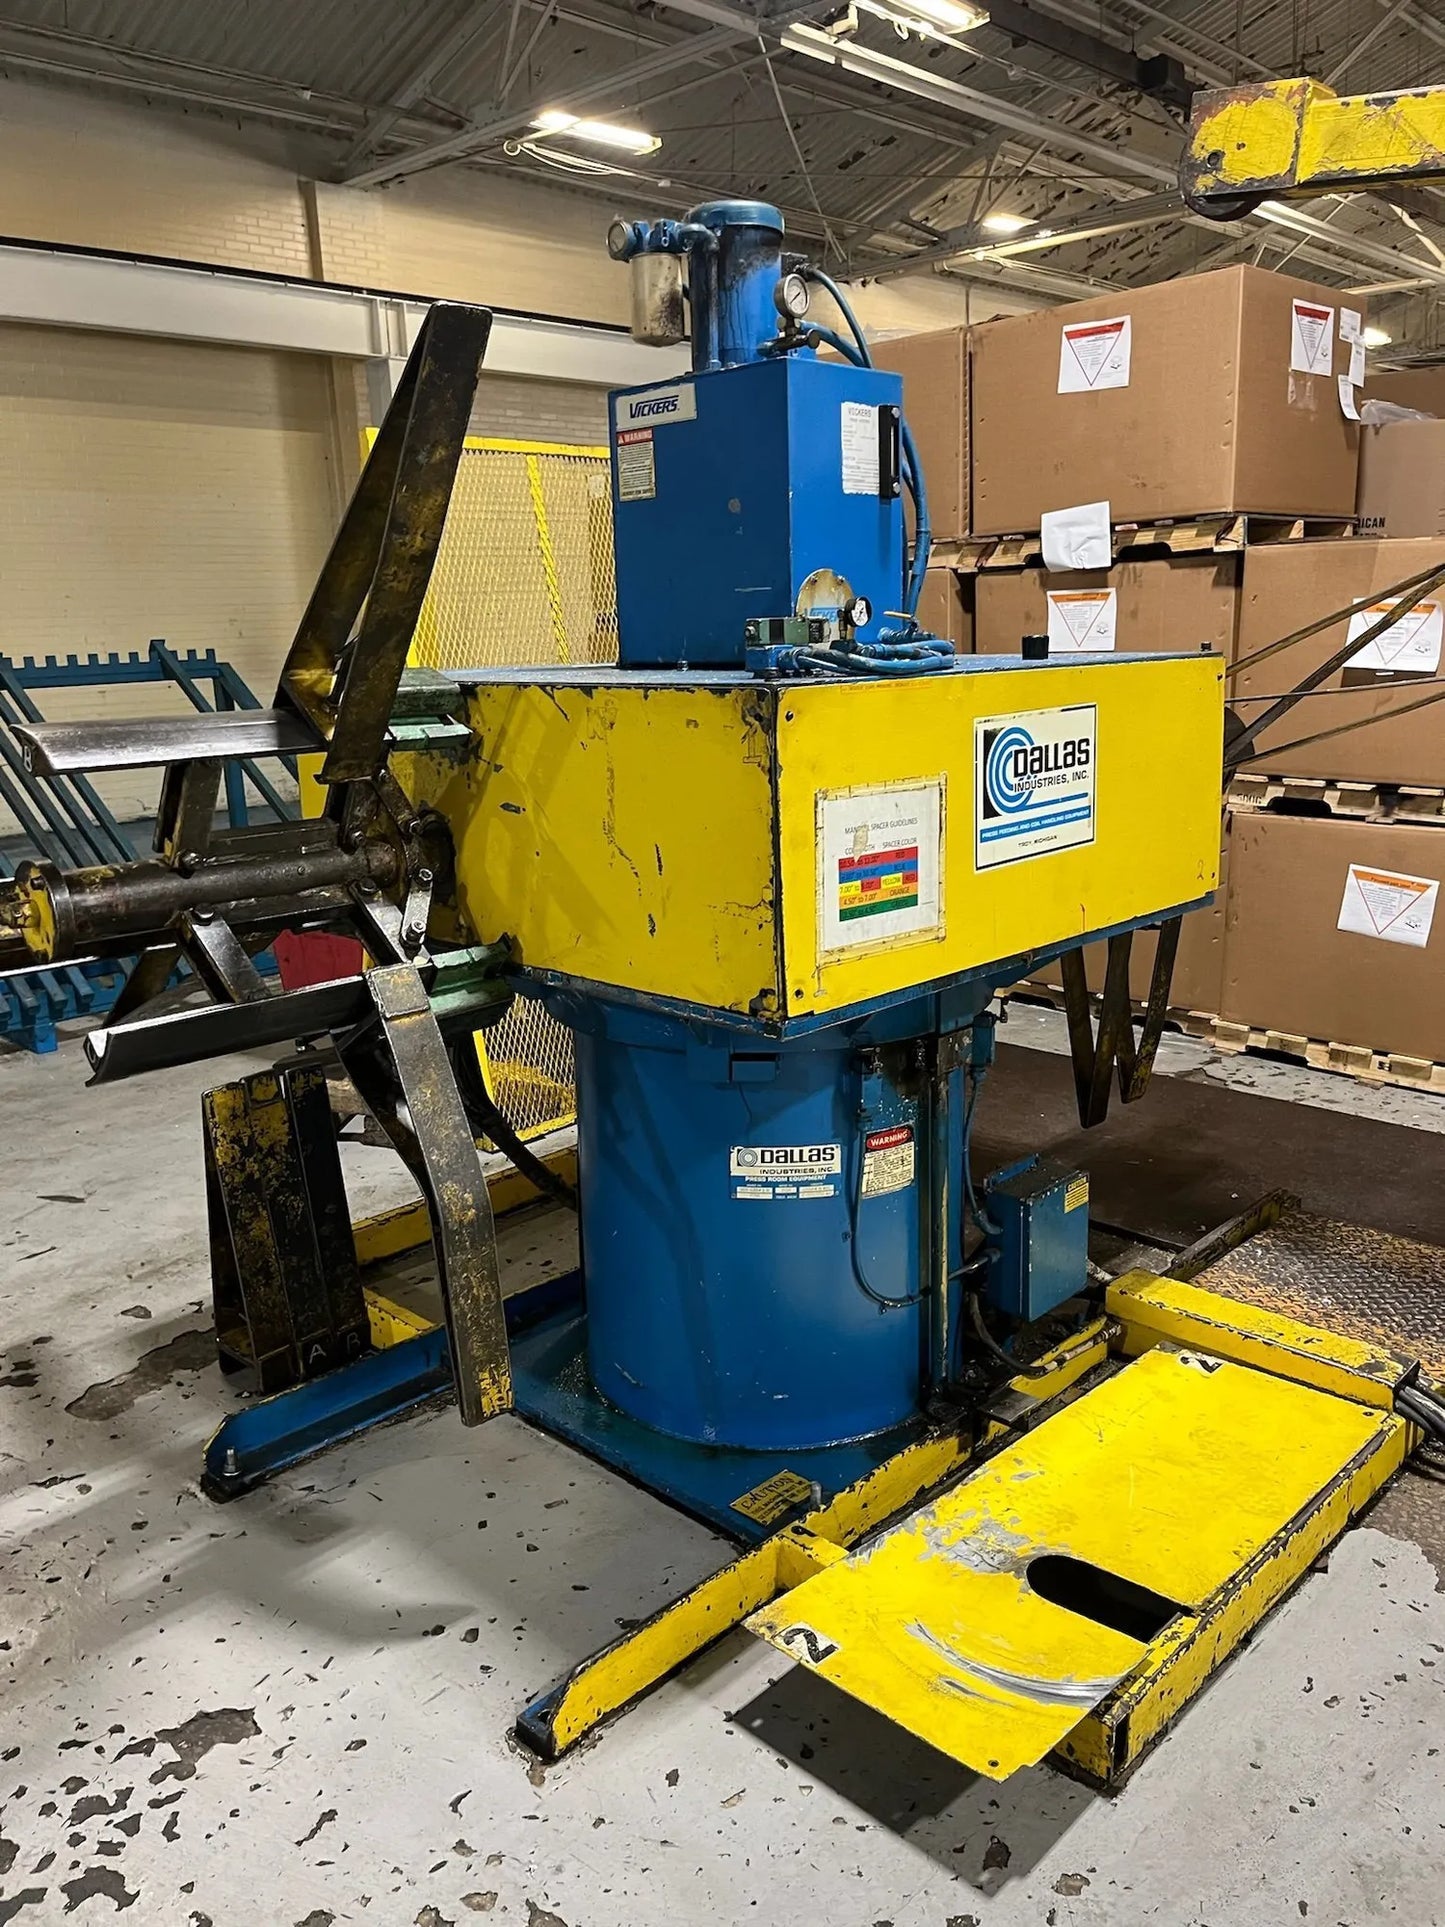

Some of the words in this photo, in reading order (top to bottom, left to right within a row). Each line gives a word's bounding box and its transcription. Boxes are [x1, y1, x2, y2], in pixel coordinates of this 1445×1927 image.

[630, 395, 679, 418] VICKERS
[1013, 774, 1070, 793] INDUSTRIES,
[1072, 770, 1090, 781] INC.
[871, 820, 889, 831] SPACER
[890, 817, 918, 828] GUIDELINES
[882, 839, 901, 850] SPACER
[870, 1130, 908, 1147] WARNING
[759, 1167, 817, 1175] INDUSTRIES,
[309, 1344, 327, 1365] A
[783, 1627, 839, 1664] 2
